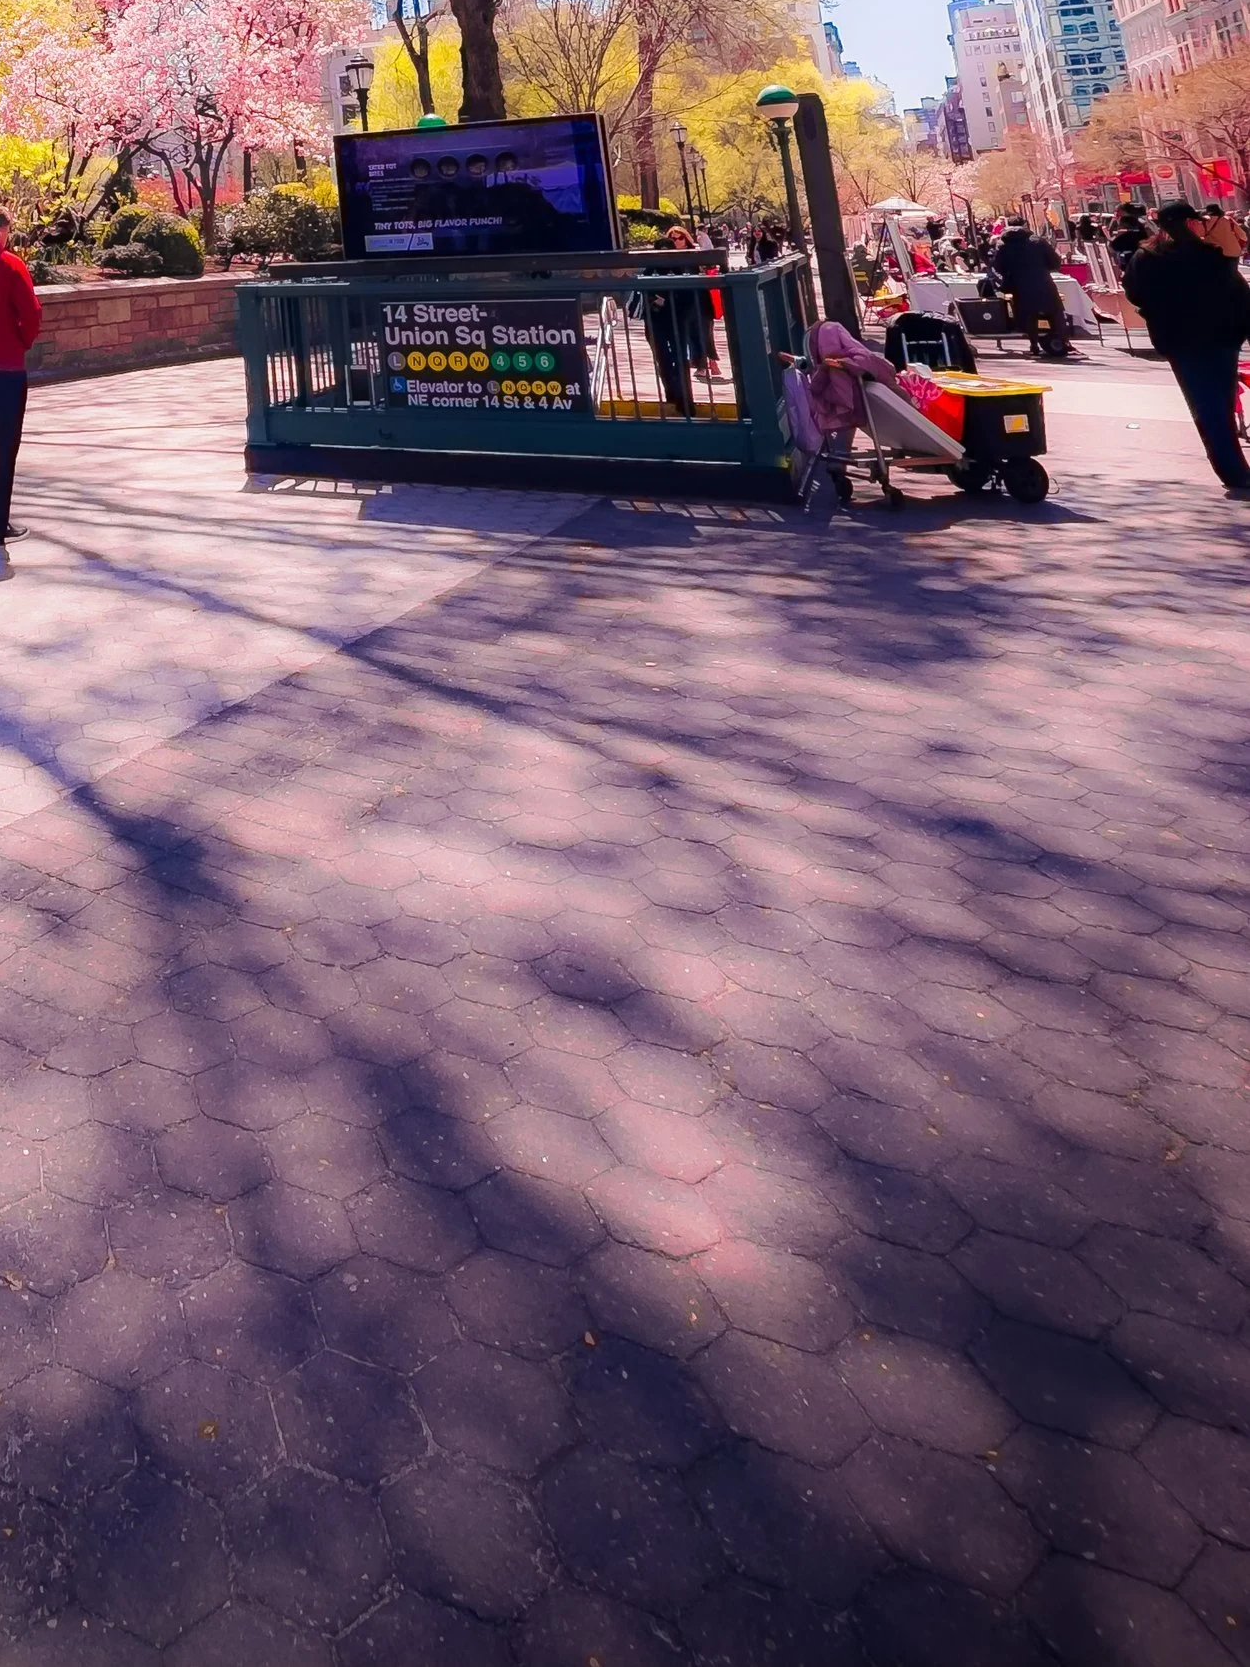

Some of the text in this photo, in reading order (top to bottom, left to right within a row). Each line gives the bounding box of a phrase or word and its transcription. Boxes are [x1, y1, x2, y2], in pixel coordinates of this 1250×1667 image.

[374, 222, 392, 230] TINY
[418, 220, 433, 229] BIG
[435, 218, 467, 228] FLAVOR
[469, 216, 503, 226] PUNCH!
[383, 304, 488, 323] 14 Street-
[384, 324, 576, 350] Union Sq Station
[473, 356, 486, 367] W
[406, 380, 464, 394] Elevator
[468, 380, 482, 394] to
[565, 382, 581, 396] at
[408, 394, 572, 410] NE corner 14 St & 4 Av
